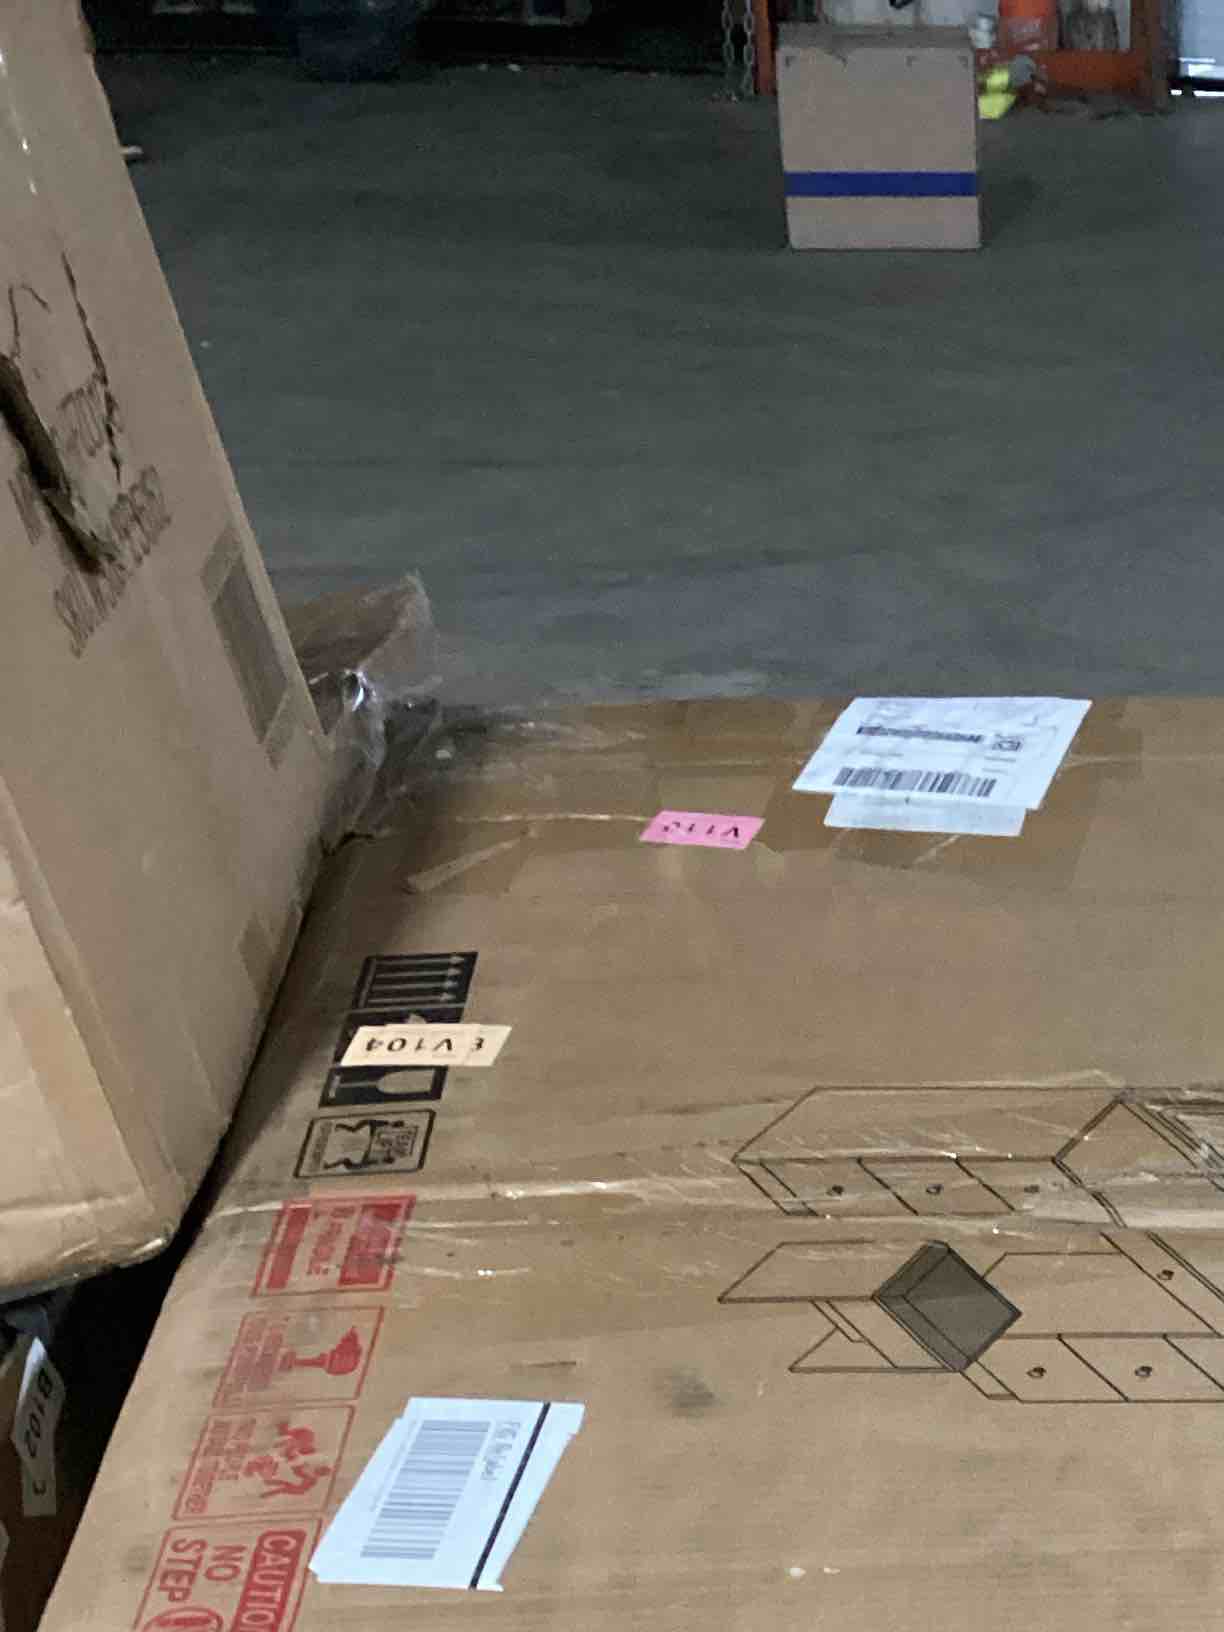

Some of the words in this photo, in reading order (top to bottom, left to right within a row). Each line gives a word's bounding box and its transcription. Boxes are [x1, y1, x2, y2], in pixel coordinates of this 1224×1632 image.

[364, 1036, 454, 1053] V104
[157, 1537, 208, 1603] STEP
[203, 1543, 247, 1583] NO
